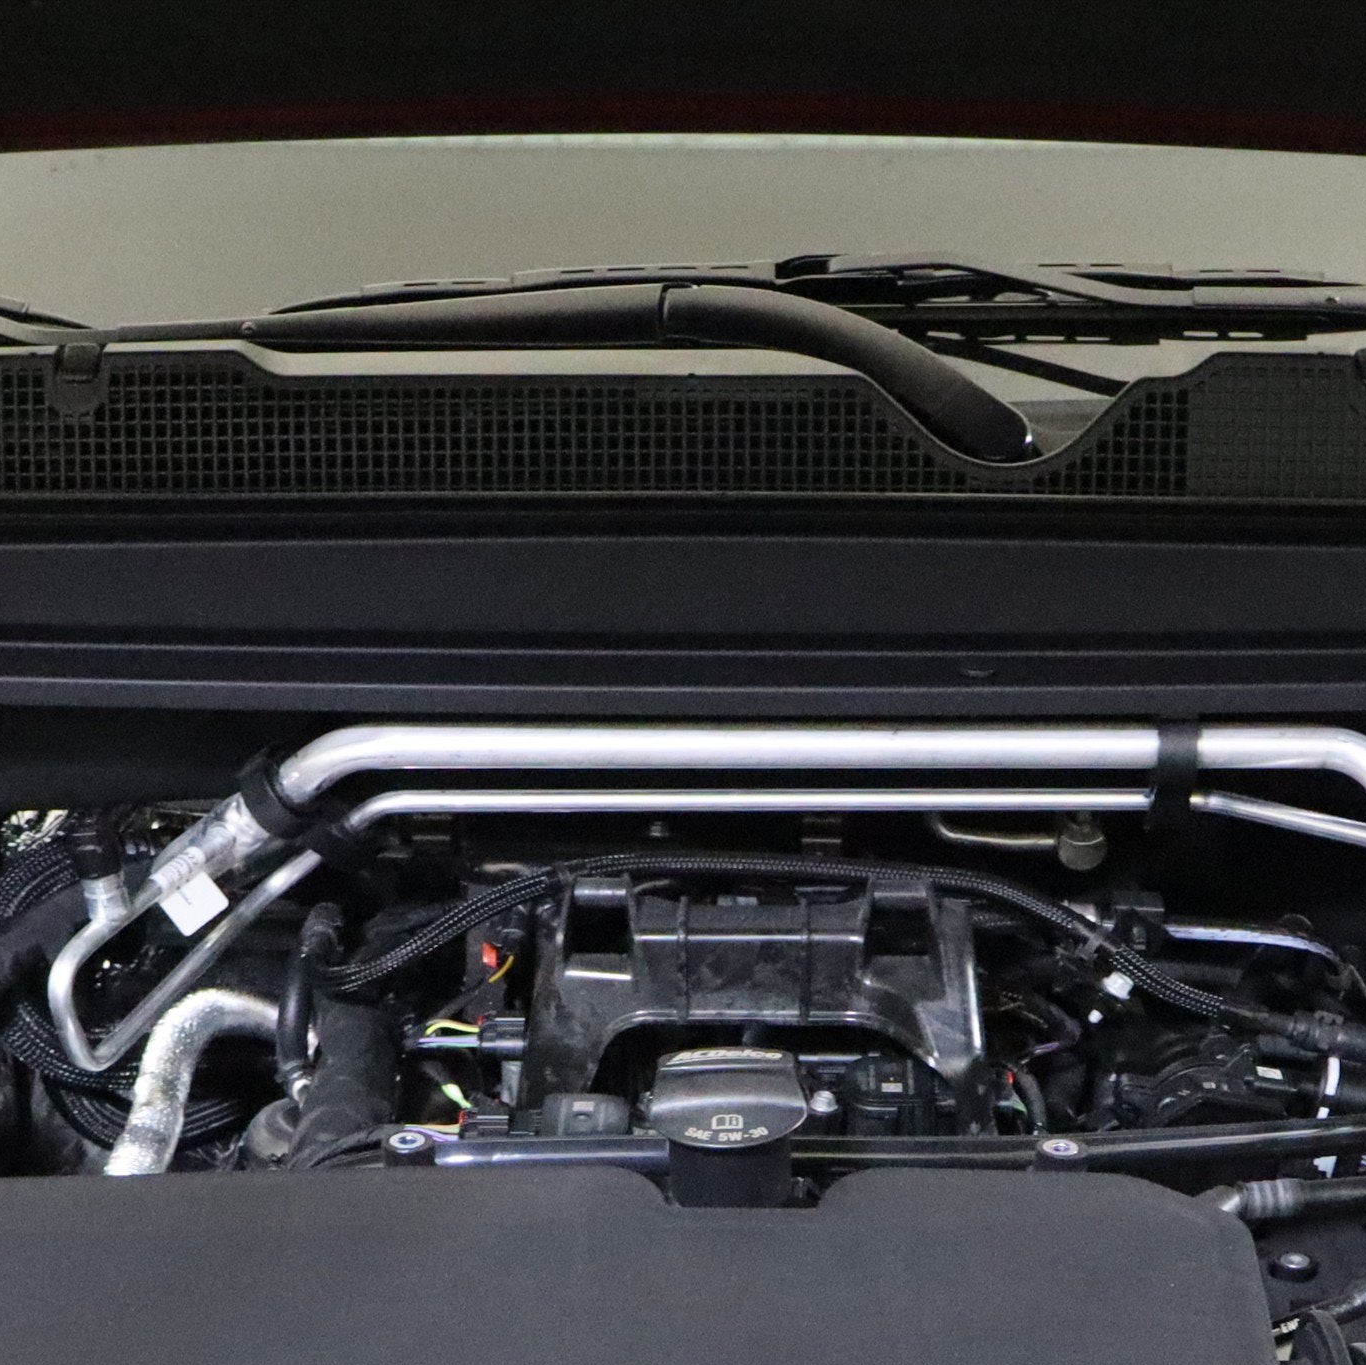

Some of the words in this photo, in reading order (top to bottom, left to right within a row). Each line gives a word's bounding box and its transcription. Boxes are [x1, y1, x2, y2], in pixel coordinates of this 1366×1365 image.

[666, 1049, 783, 1066] ACDelco
[684, 1127, 713, 1141] SAE
[718, 1126, 769, 1142] 5W-30
